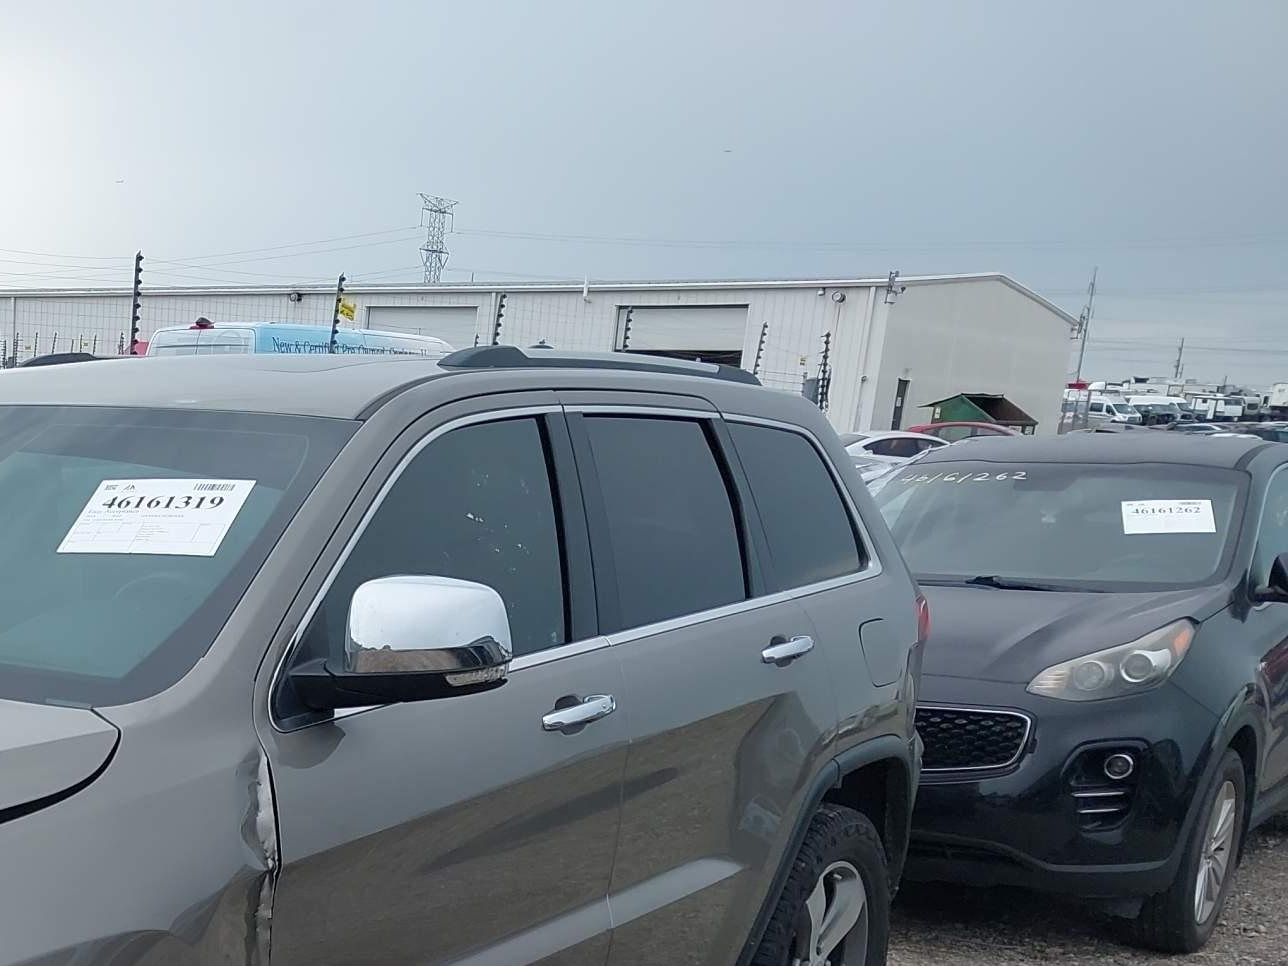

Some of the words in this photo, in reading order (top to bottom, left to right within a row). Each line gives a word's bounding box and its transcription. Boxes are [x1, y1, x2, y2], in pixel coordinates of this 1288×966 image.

[272, 336, 292, 353] New
[295, 340, 302, 353] &
[101, 495, 225, 510] 46161319
